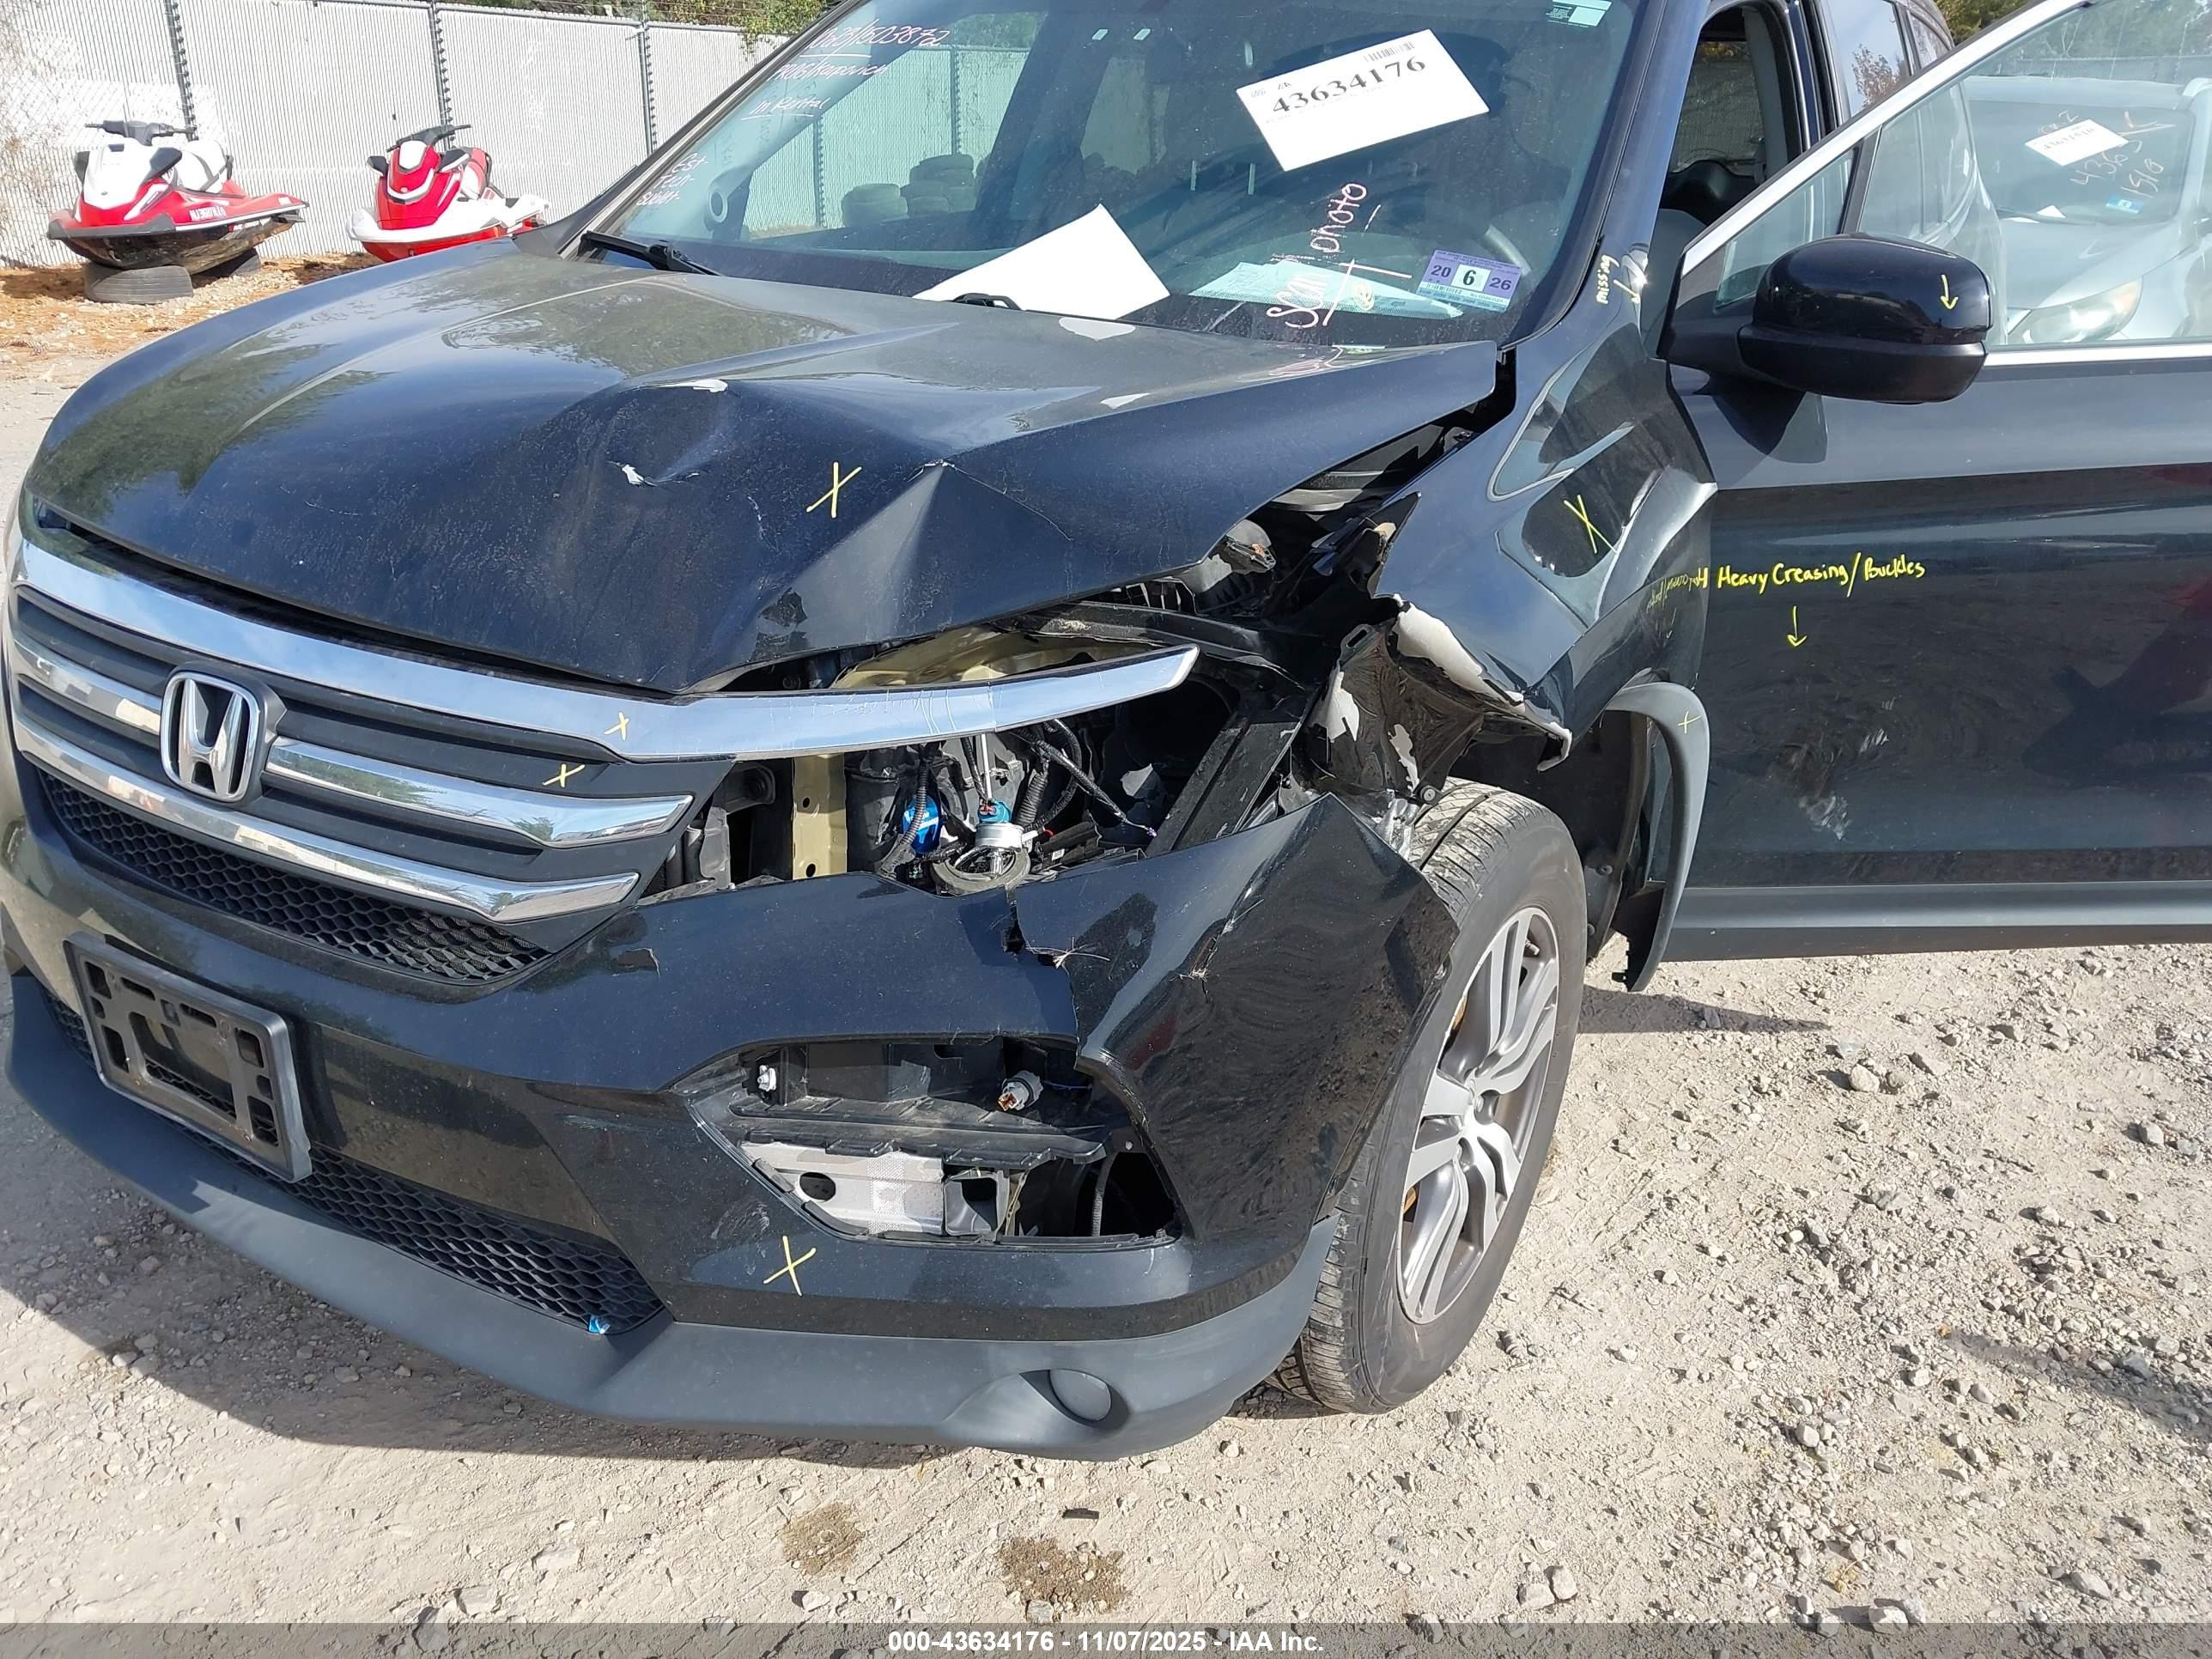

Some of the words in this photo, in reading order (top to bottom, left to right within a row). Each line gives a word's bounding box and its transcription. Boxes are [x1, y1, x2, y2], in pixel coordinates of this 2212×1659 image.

[1273, 56, 1426, 112] 43634176
[1431, 264, 1452, 277] 20
[1462, 270, 1477, 286] 6
[1489, 276, 1512, 291] 26
[1717, 564, 1768, 594] Heavy
